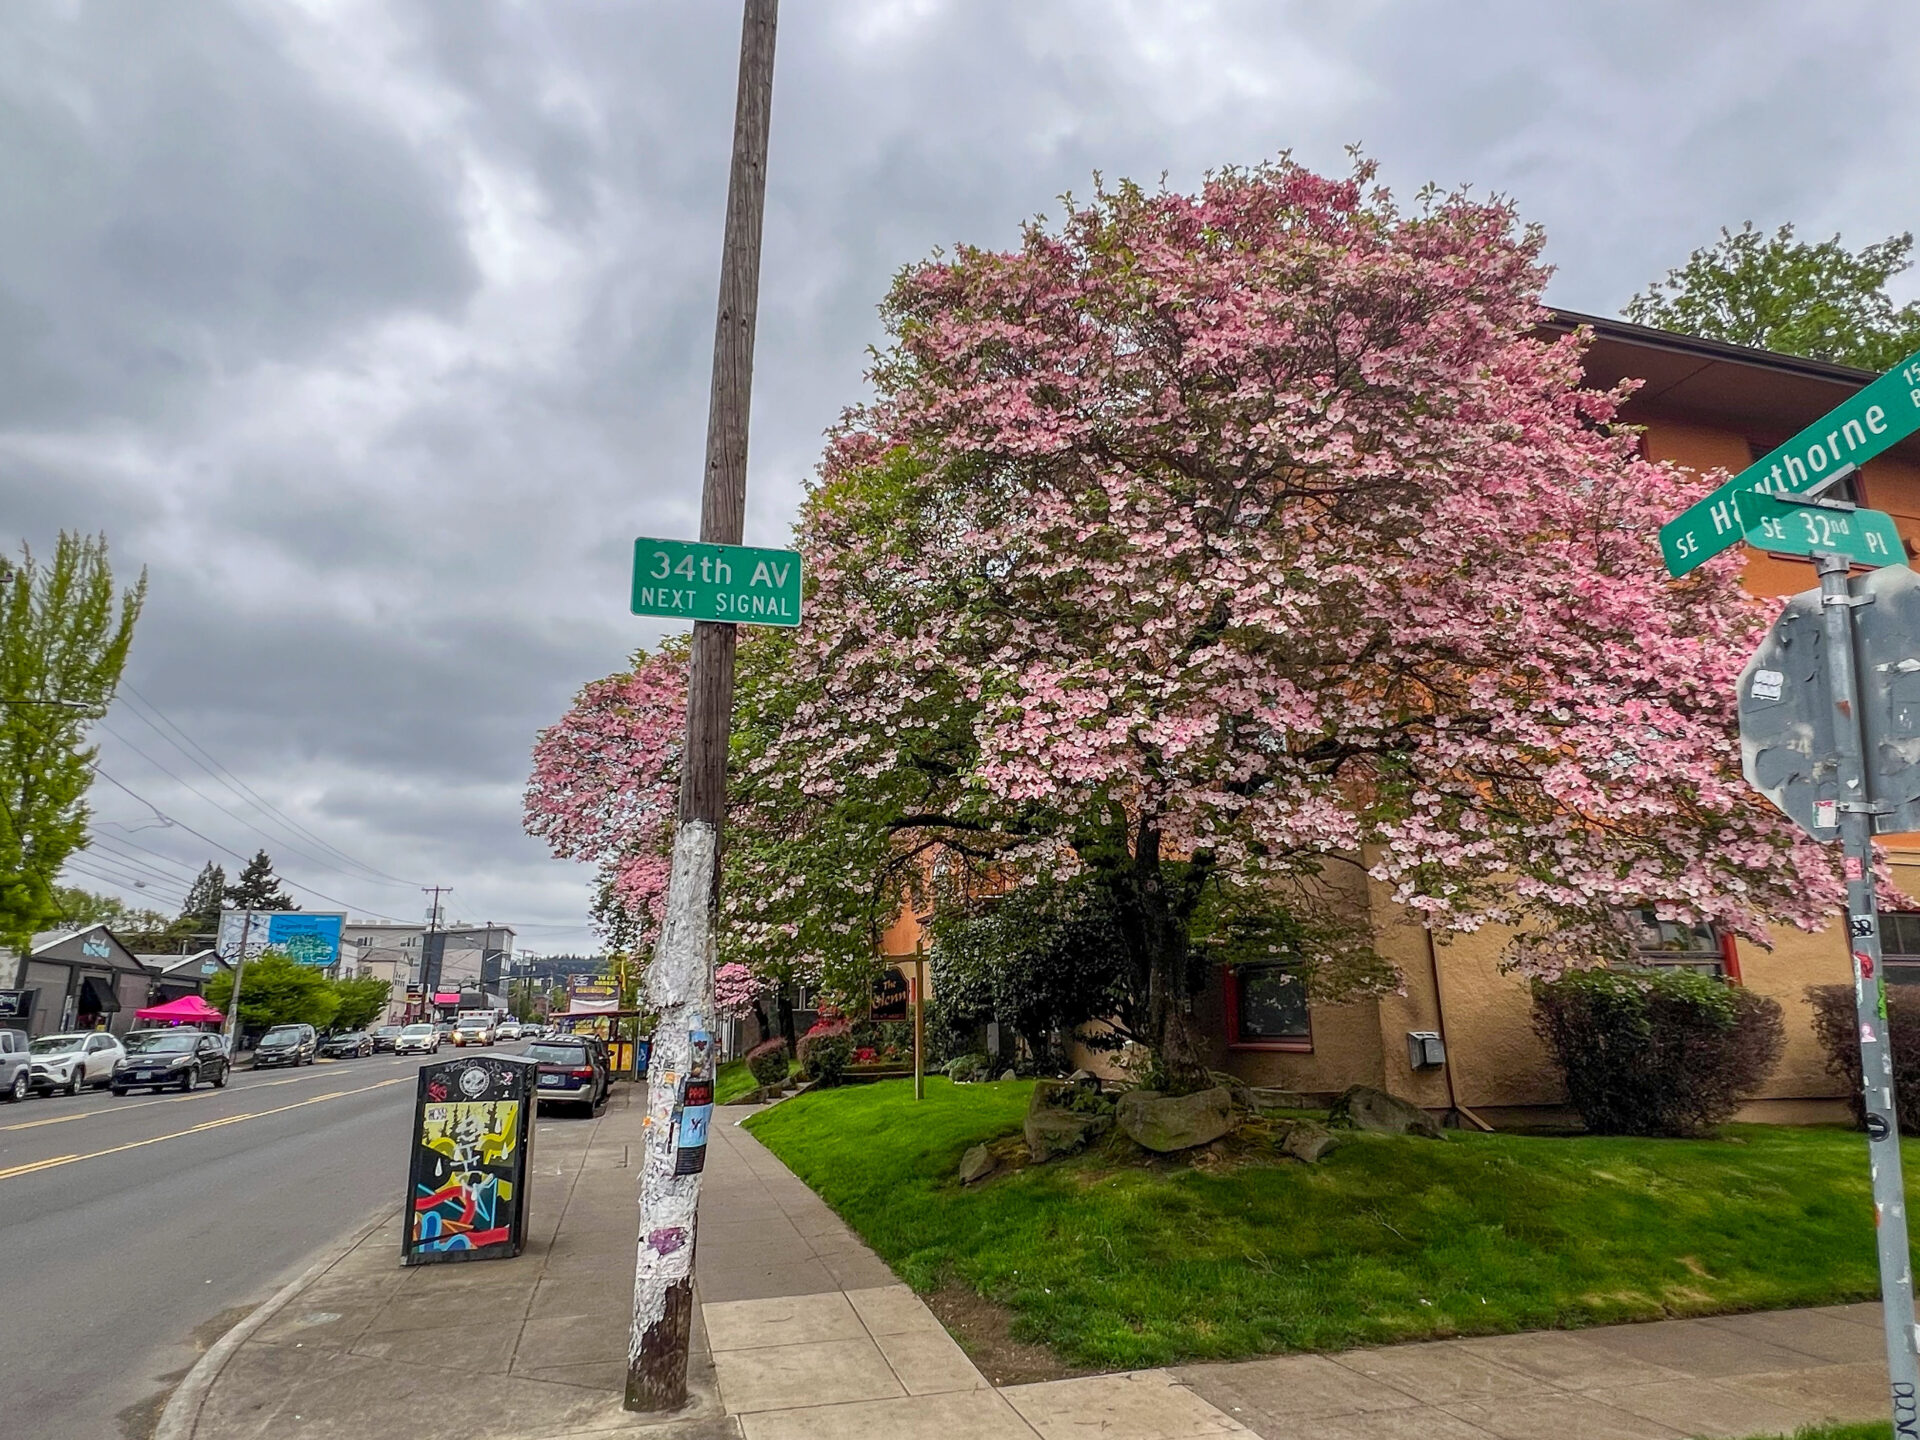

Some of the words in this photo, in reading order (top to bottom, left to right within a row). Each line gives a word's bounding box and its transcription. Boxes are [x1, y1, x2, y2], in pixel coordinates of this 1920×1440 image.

[1675, 531, 1699, 560] SE
[1710, 404, 1888, 536] Hwthorne
[1760, 515, 1786, 541] SE
[1799, 512, 1850, 547] 32nd
[650, 551, 732, 585] 34th
[749, 560, 791, 589] AV
[641, 587, 696, 610] NEXT
[715, 593, 792, 616] SIGNAL
[872, 990, 907, 1009] Glenn
[882, 979, 897, 990] The
